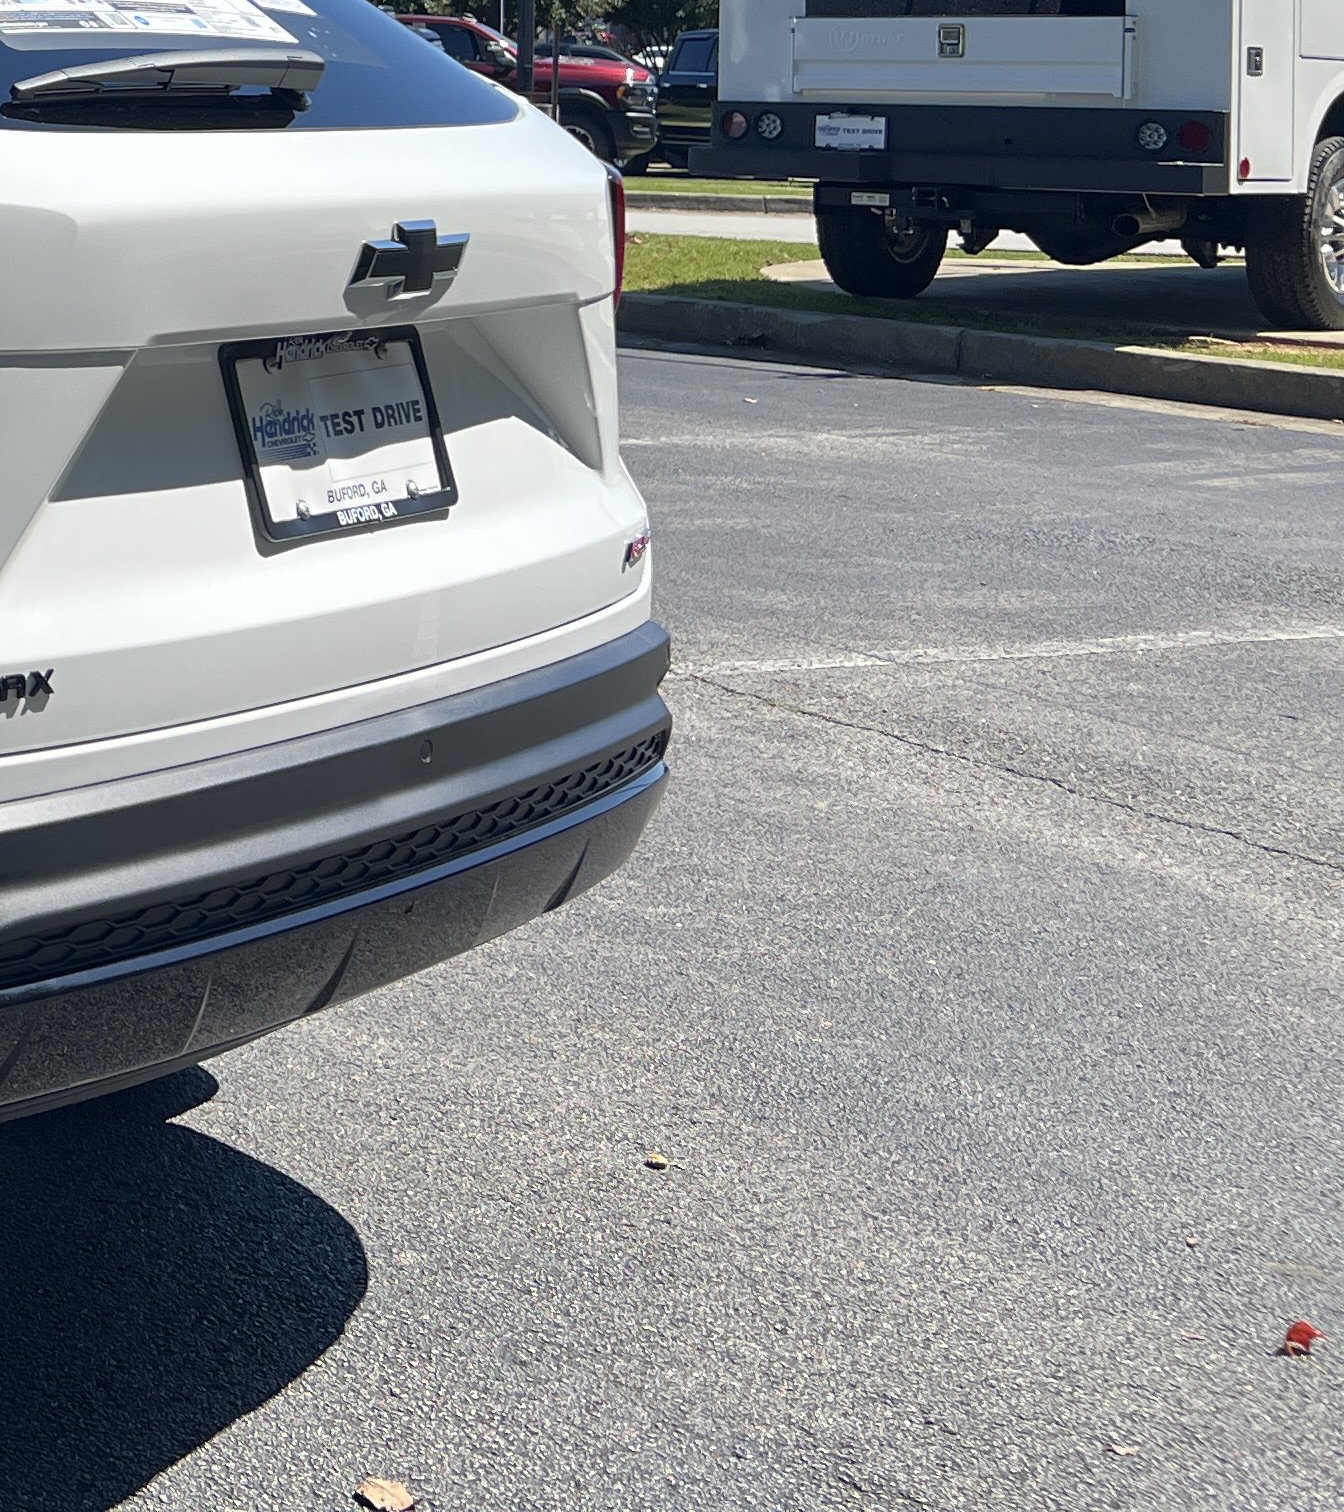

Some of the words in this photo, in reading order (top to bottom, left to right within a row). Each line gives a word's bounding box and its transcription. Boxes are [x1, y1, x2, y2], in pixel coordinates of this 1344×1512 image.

[252, 408, 316, 448] Hendrick
[318, 408, 366, 439] TEST
[372, 399, 423, 430] DRIVE
[326, 483, 371, 504] BUFORD,
[371, 479, 388, 495] GA
[336, 505, 383, 526] BUFORD,
[380, 501, 398, 518] GA
